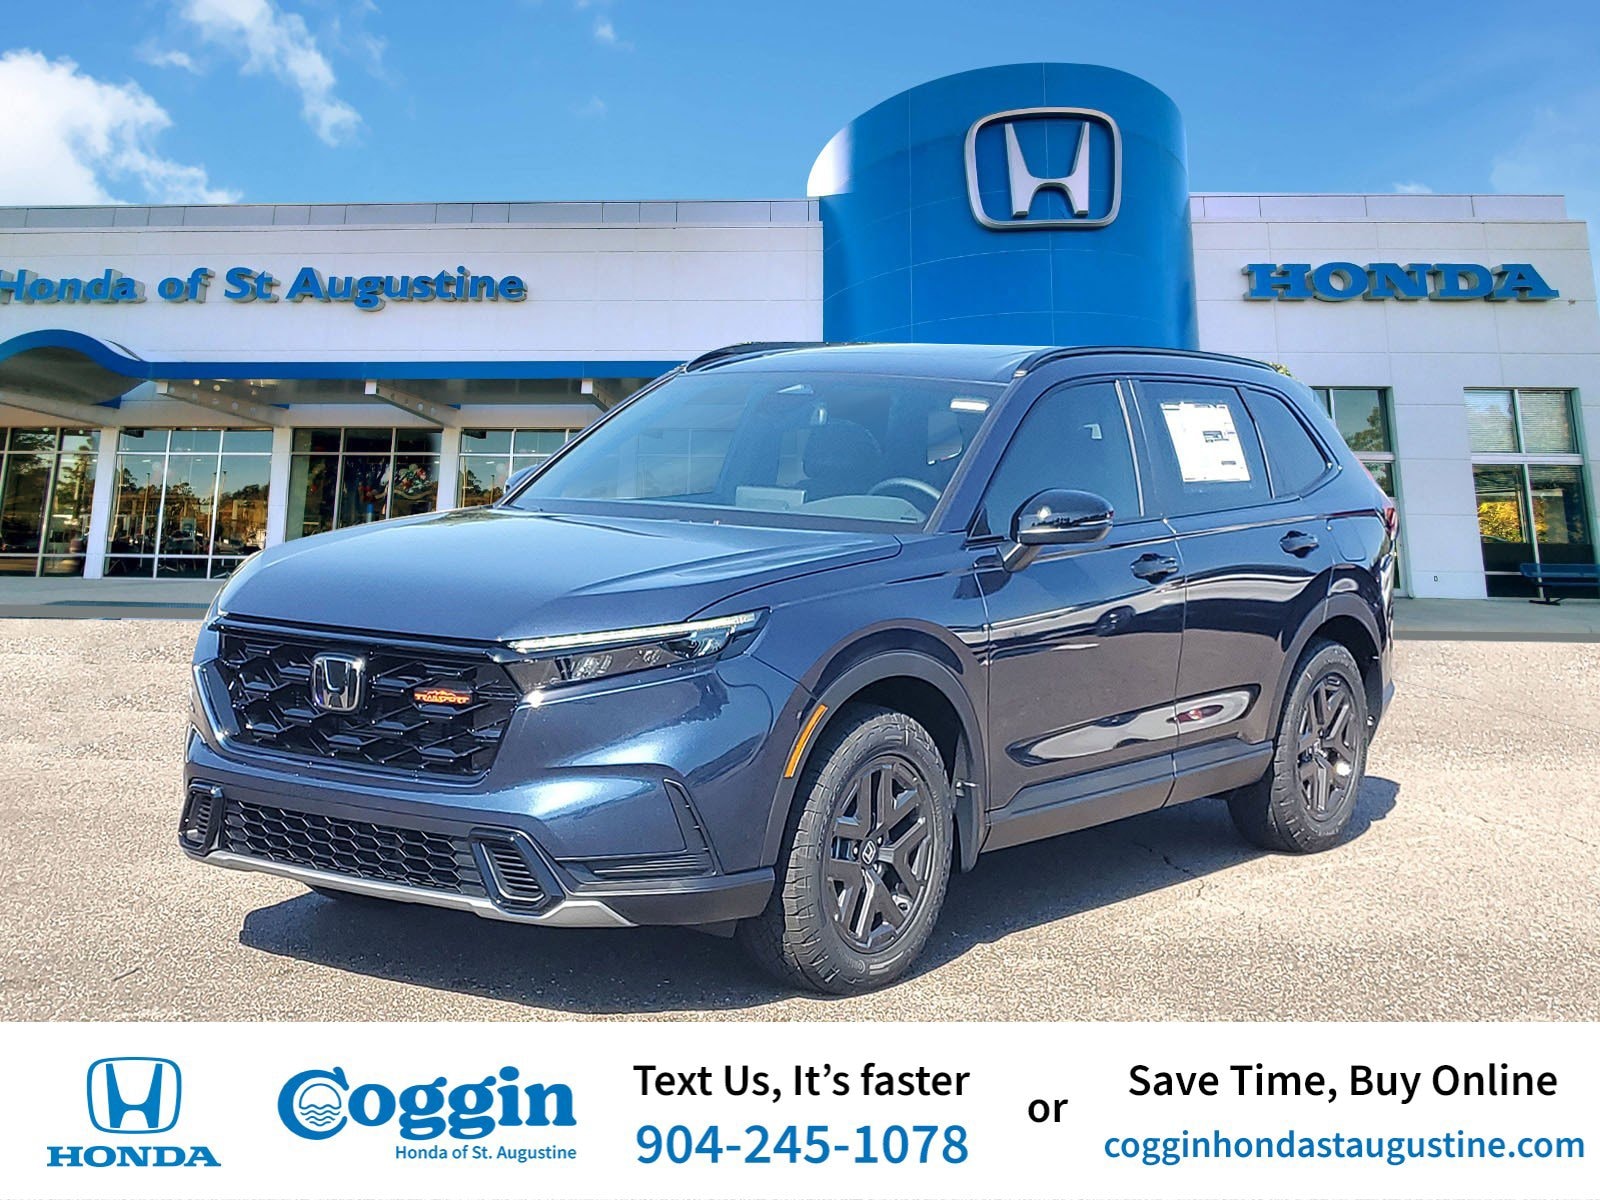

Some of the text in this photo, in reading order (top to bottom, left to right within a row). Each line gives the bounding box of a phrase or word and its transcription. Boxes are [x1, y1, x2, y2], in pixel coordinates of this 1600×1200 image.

[0, 266, 527, 311] Honda of St Augustine
[1243, 262, 1559, 301] HONDA
